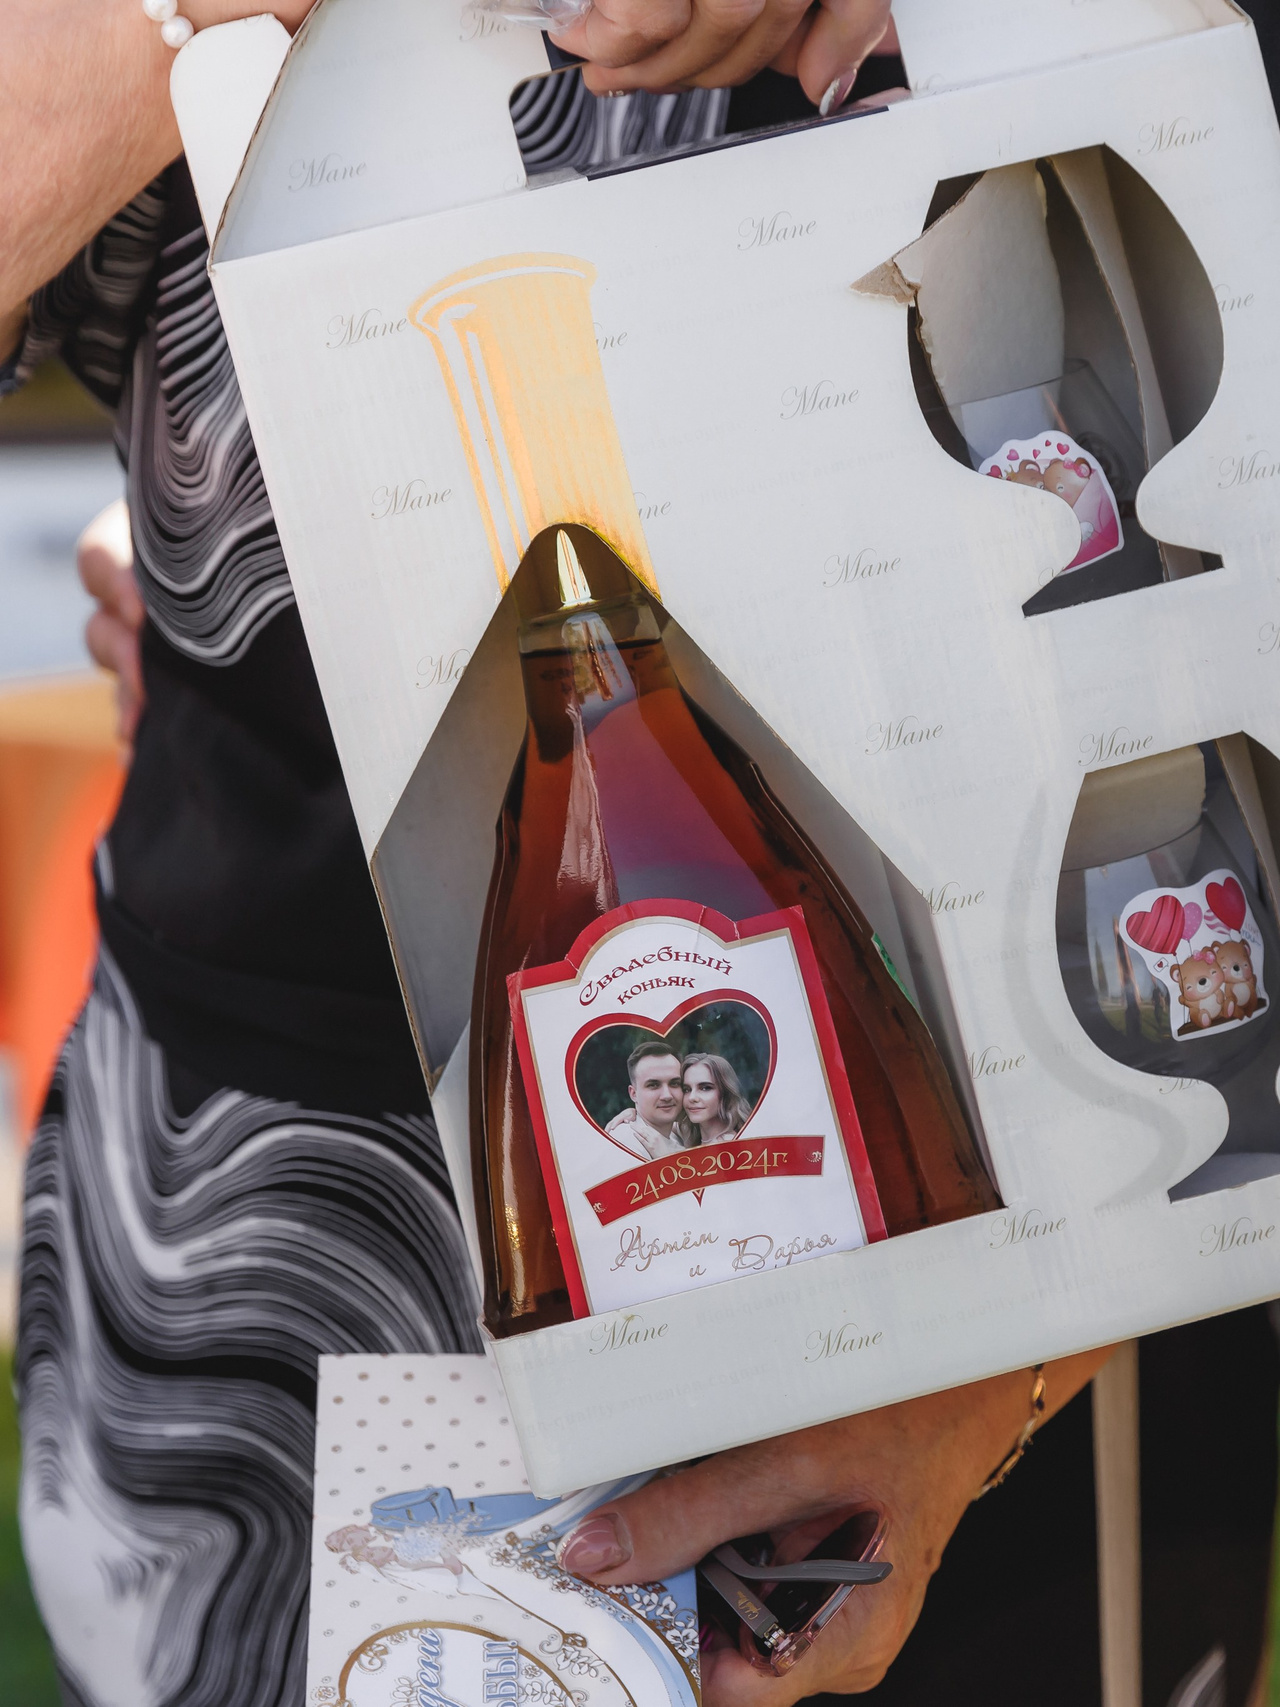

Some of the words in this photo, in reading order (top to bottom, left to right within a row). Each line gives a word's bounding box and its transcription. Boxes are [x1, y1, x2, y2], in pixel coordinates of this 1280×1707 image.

[1137, 117, 1215, 155] Mane
[287, 157, 367, 192] Mane
[736, 211, 817, 250] Mane
[325, 308, 407, 349] Mane
[779, 379, 859, 419] Mane
[370, 477, 452, 519] Mane
[822, 547, 902, 587] Mane
[415, 648, 472, 689] Ma
[864, 715, 945, 755] Mane
[1077, 726, 1155, 767] Mane
[579, 945, 734, 1007] Свадебный
[617, 975, 696, 1006] коньяк
[989, 1211, 1067, 1250] Mane
[1198, 1214, 1276, 1257] Mane
[589, 1314, 669, 1355] Mane
[804, 1322, 884, 1363] Mane
